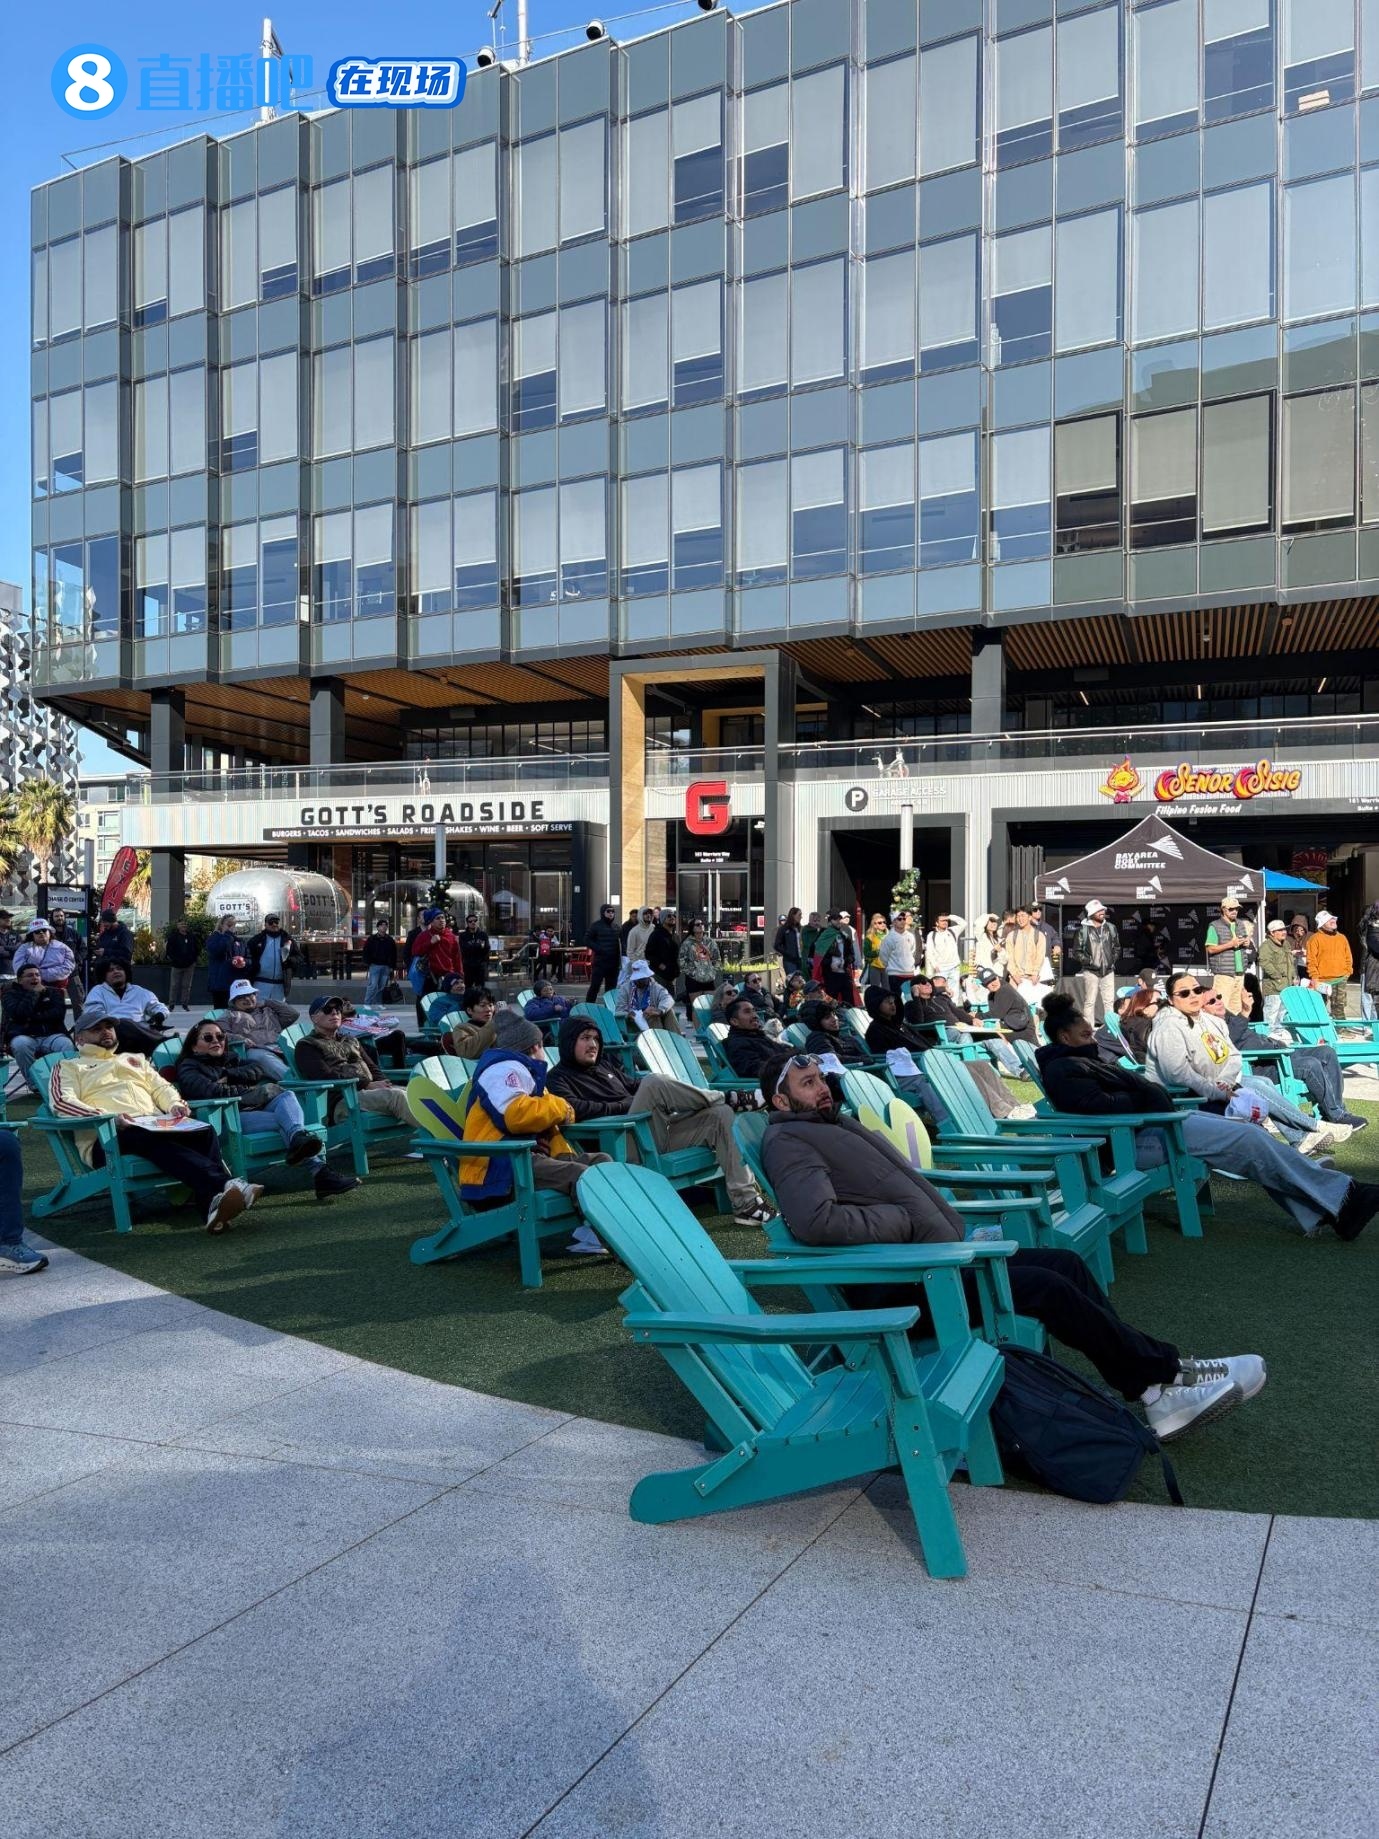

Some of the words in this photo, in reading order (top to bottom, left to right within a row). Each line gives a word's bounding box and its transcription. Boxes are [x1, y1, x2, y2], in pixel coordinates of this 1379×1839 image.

[1160, 762, 1234, 797] SEÑOR
[1237, 759, 1302, 797] SISIG
[851, 790, 865, 807] P
[301, 804, 387, 826] GOTT'S
[402, 801, 544, 824] ROADSIDE
[686, 780, 731, 835] G
[1155, 805, 1187, 817] Filipino
[1189, 804, 1218, 815] Fusion
[1219, 803, 1242, 814] Food
[271, 830, 302, 838] BURGERS
[307, 829, 330, 837] TACOS
[335, 828, 381, 837] SANDWICHES
[387, 827, 414, 835] SALADS
[420, 826, 437, 835] FRIE
[445, 825, 473, 834] SHAKES
[479, 825, 500, 833] WINE
[506, 824, 524, 832] BEER
[530, 824, 549, 832] SOFT
[550, 823, 573, 831] SERVE
[1115, 852, 1134, 860] BAY
[1134, 851, 1158, 859] AREA
[219, 903, 250, 911] GOTT'S
